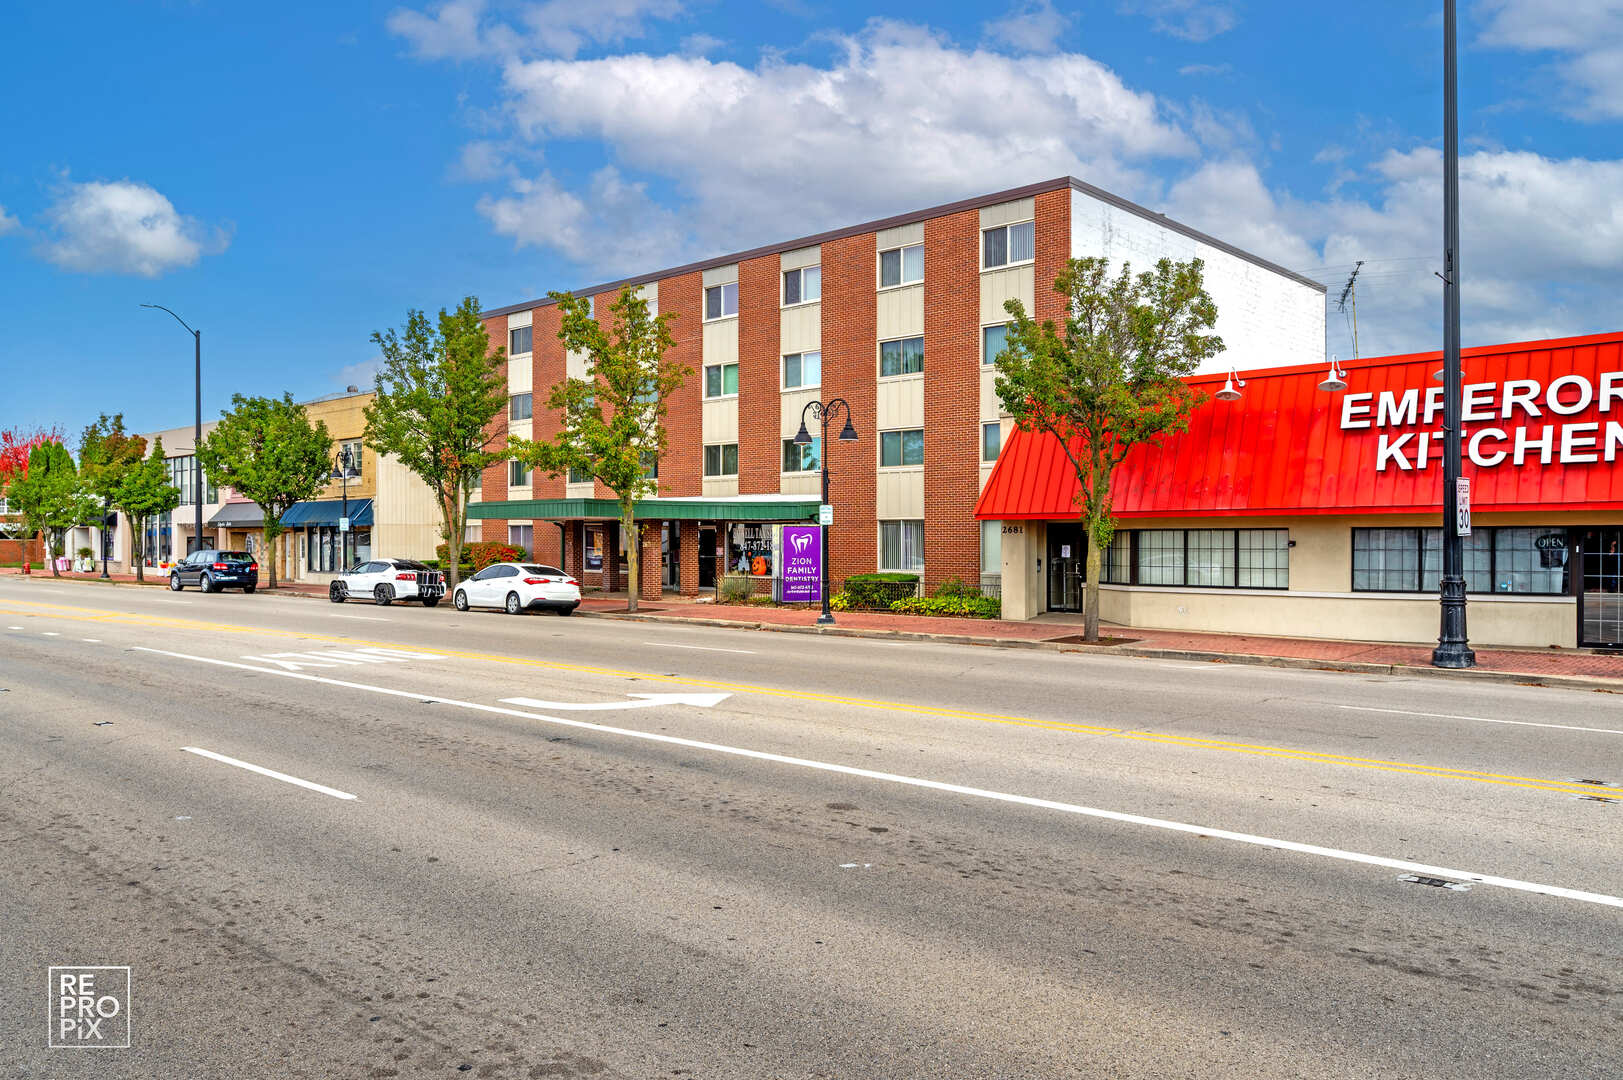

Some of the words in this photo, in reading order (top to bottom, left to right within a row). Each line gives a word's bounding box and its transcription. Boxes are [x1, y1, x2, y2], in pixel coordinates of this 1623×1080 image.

[1459, 508, 1470, 529] 30
[1002, 526, 1023, 534] 2681
[1538, 536, 1563, 547] OPEN
[791, 557, 812, 565] ZION
[787, 566, 817, 574] FAMILY
